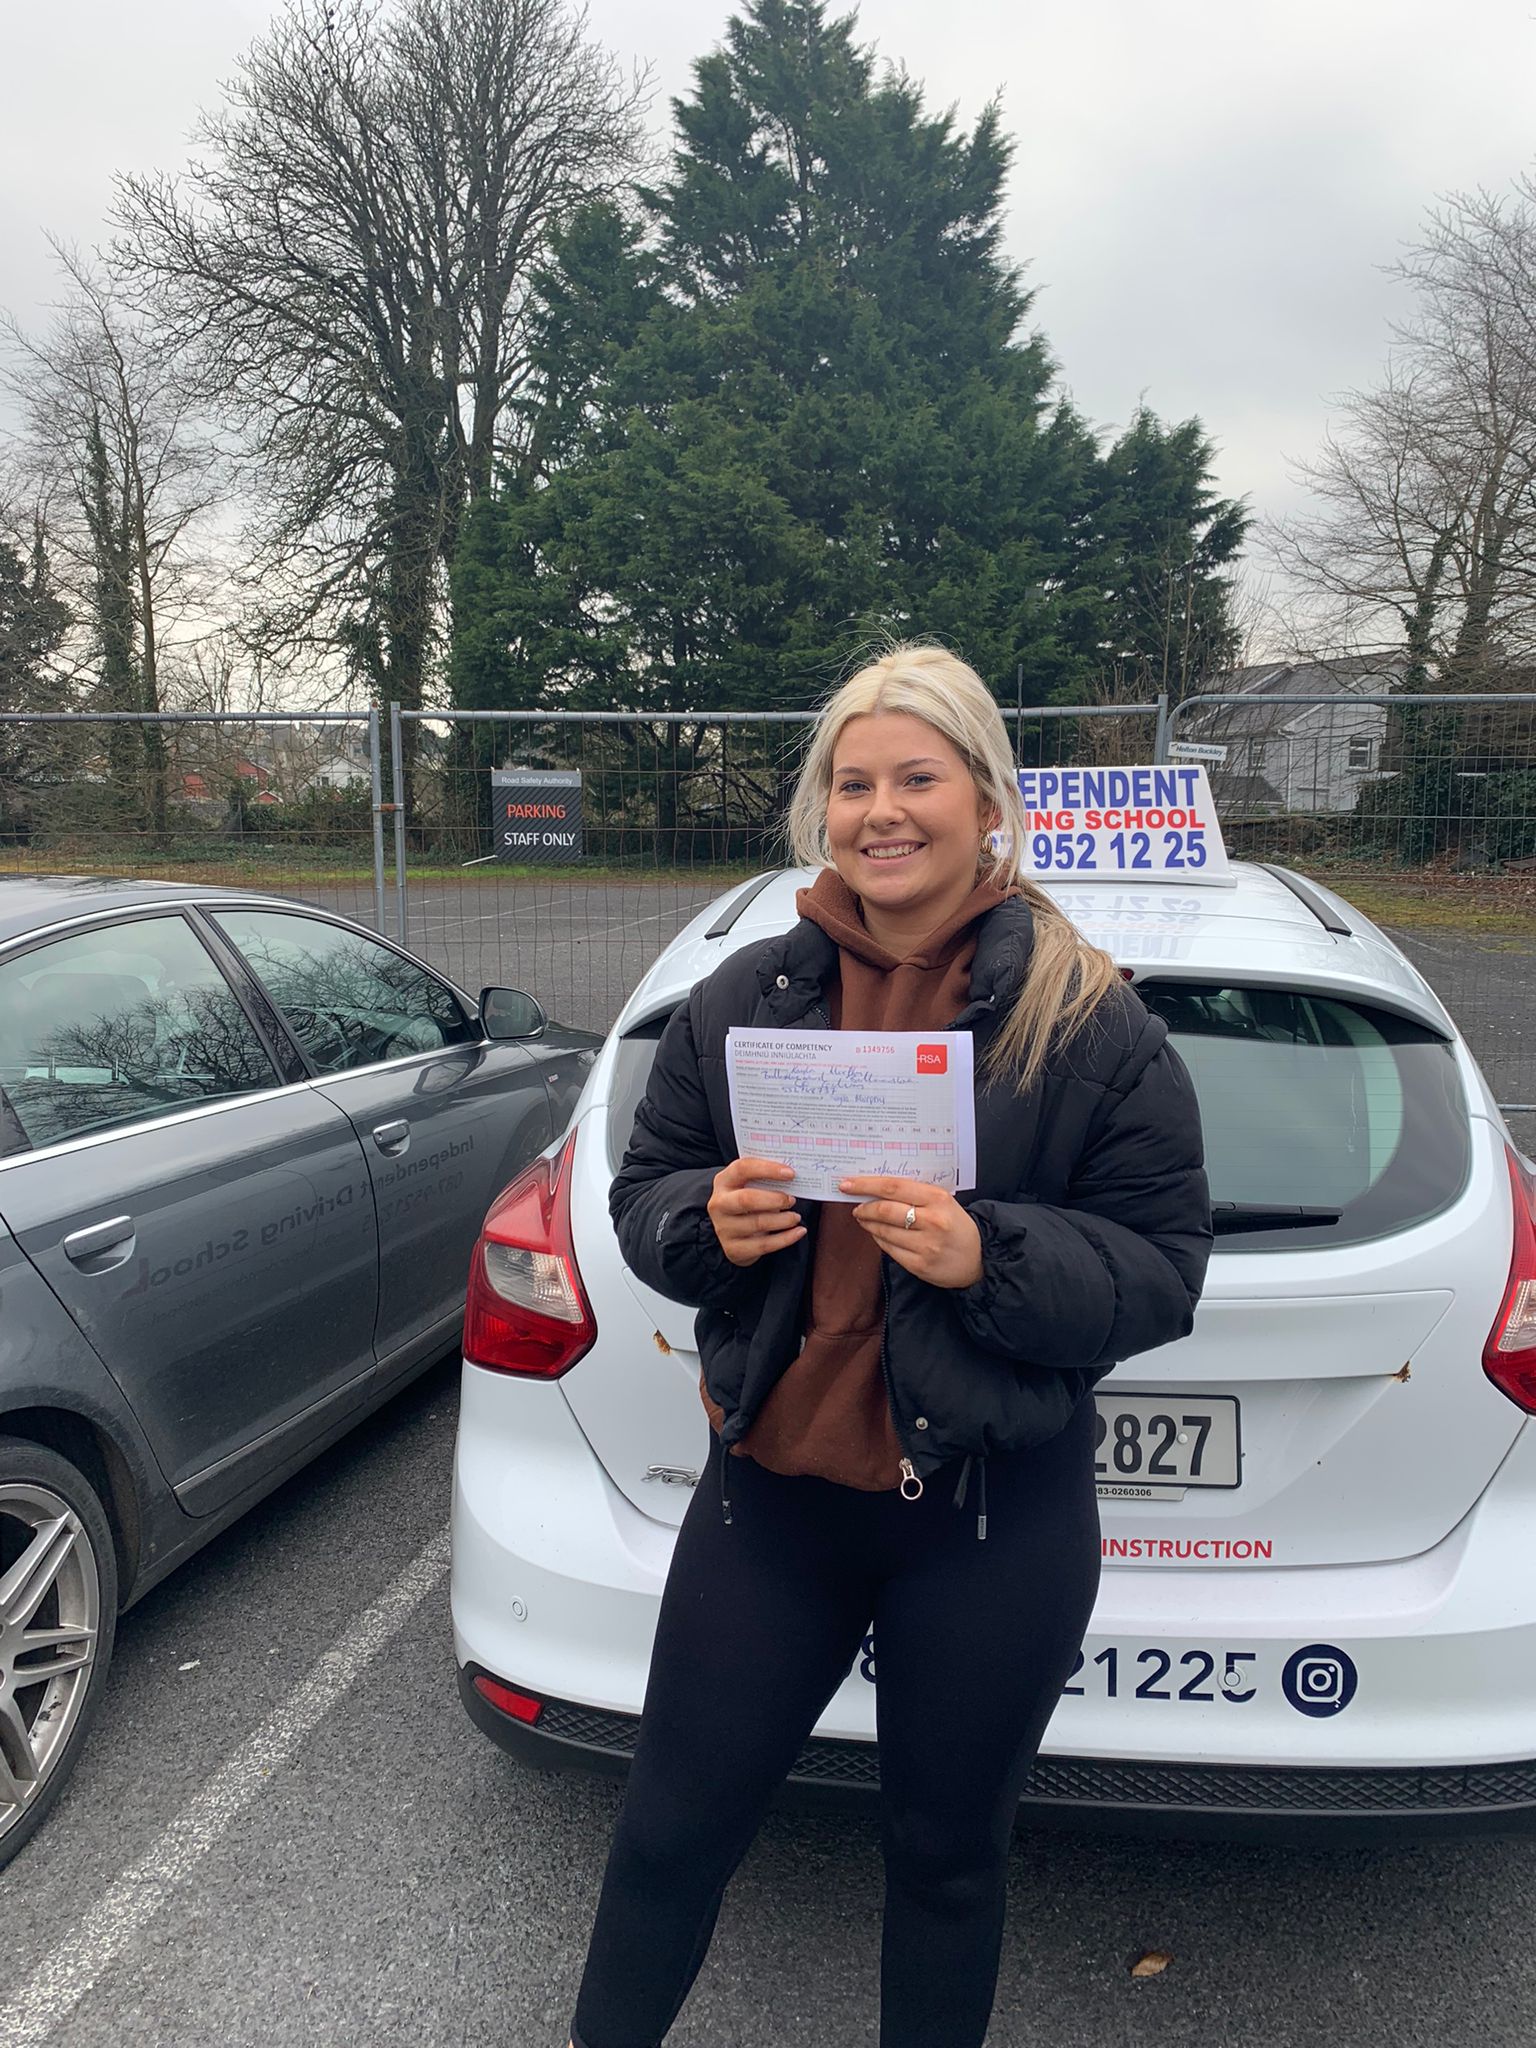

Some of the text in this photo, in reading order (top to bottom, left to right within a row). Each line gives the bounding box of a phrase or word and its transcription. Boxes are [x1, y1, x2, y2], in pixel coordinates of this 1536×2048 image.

[501, 776, 574, 785] Road Safety Authority
[507, 804, 567, 818] PARKING
[1085, 809, 1206, 830] SCHOOL
[504, 832, 576, 846] STAFF ONLY
[1033, 833, 1097, 870] 952
[1110, 832, 1152, 869] 12
[1163, 831, 1207, 869] 25
[734, 1040, 833, 1052] CERTIFICATE OF COMPETENCY
[919, 1054, 941, 1064] RSA
[1102, 1538, 1273, 1559] INSTRUCTION
